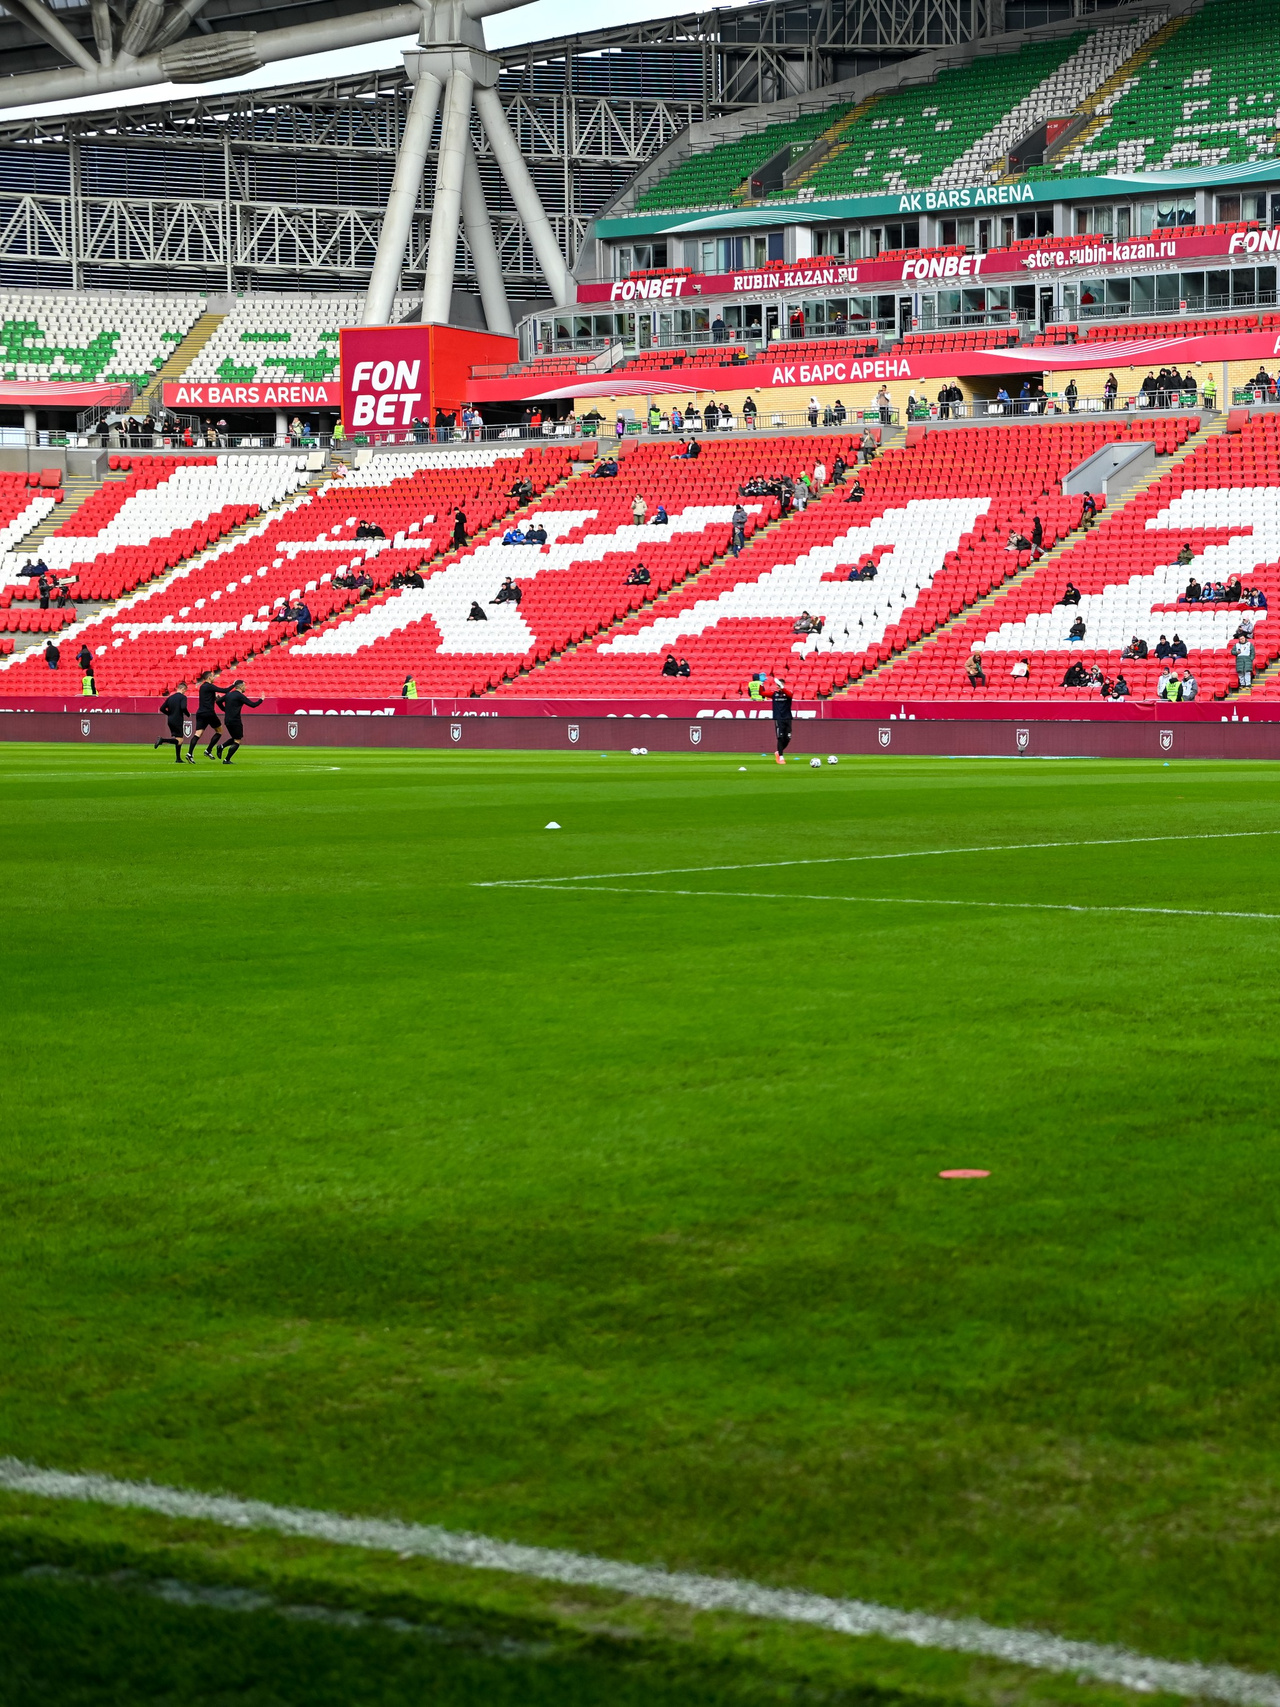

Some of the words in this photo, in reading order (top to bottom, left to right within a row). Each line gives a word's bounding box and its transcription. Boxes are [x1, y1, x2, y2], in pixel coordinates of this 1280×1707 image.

[898, 193, 922, 212] AK
[926, 188, 970, 208] BARS
[974, 184, 1034, 205] ARENA
[901, 254, 987, 280] FONBET
[1028, 241, 1176, 269] store.rubin-kazan.ru
[610, 277, 687, 300] FONBET
[733, 267, 858, 291] RUBIN-KAZAN.RU
[351, 359, 421, 392] FON
[772, 366, 796, 384] АК
[799, 362, 846, 382] БАРС
[850, 359, 911, 380] АРЕНА
[175, 387, 203, 403] AK
[208, 386, 260, 403] BARS
[264, 385, 328, 403] ARENA
[352, 393, 421, 427] BET
